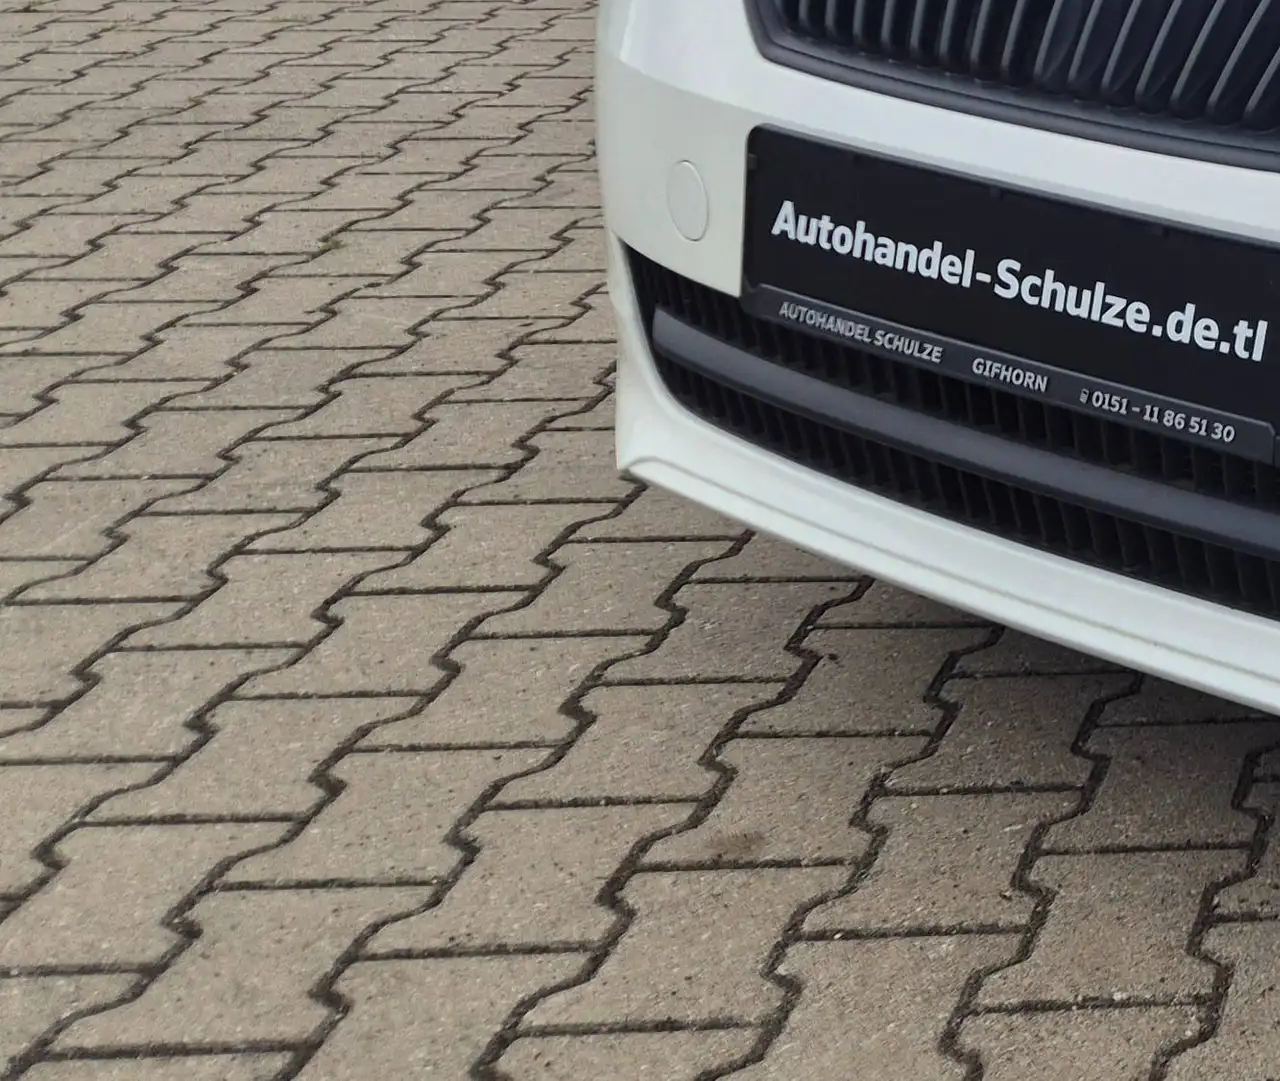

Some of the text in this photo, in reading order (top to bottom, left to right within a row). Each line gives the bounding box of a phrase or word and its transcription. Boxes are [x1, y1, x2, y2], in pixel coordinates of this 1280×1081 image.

[771, 200, 1268, 362] Autohandel-Schulze.de.tl
[779, 301, 944, 364] AUTOHANDEL SCHULZE
[972, 357, 1049, 393] GIFHORN
[1091, 390, 1128, 415] 0151
[1142, 403, 1160, 424] 11
[1162, 409, 1186, 431] 86
[1188, 416, 1209, 437] 51
[1210, 422, 1236, 444] 30
